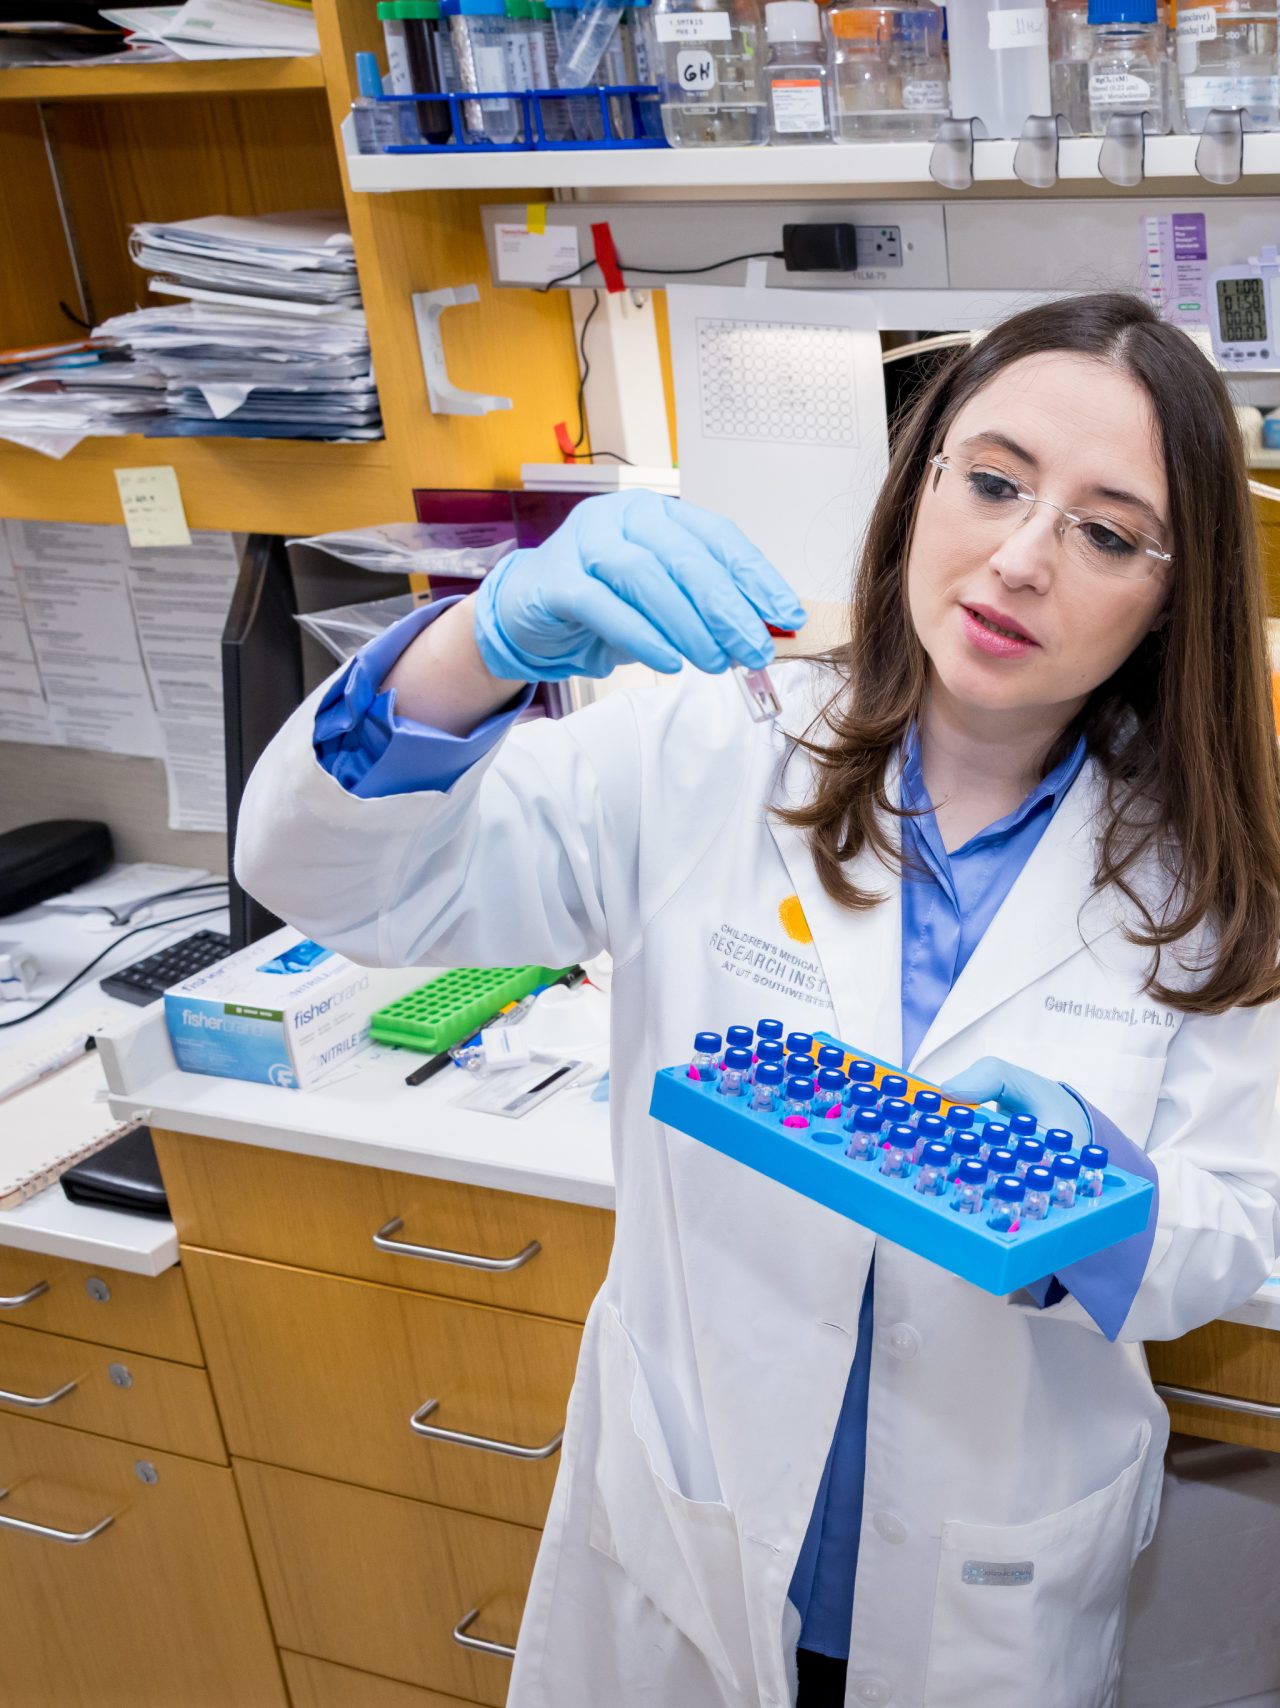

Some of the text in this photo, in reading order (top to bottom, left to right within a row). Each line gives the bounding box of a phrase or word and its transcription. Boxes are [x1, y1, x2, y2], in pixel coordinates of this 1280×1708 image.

[1201, 24, 1216, 34] Lab
[709, 932, 787, 979] RESEARCH
[721, 924, 820, 974] CHILDREN'S MEDICAL
[721, 960, 736, 973] AT
[294, 975, 370, 1030] fisherbrand
[1142, 1008, 1162, 1026] Ph.
[1164, 1011, 1176, 1029] D.
[318, 1033, 359, 1067] NITRILE
